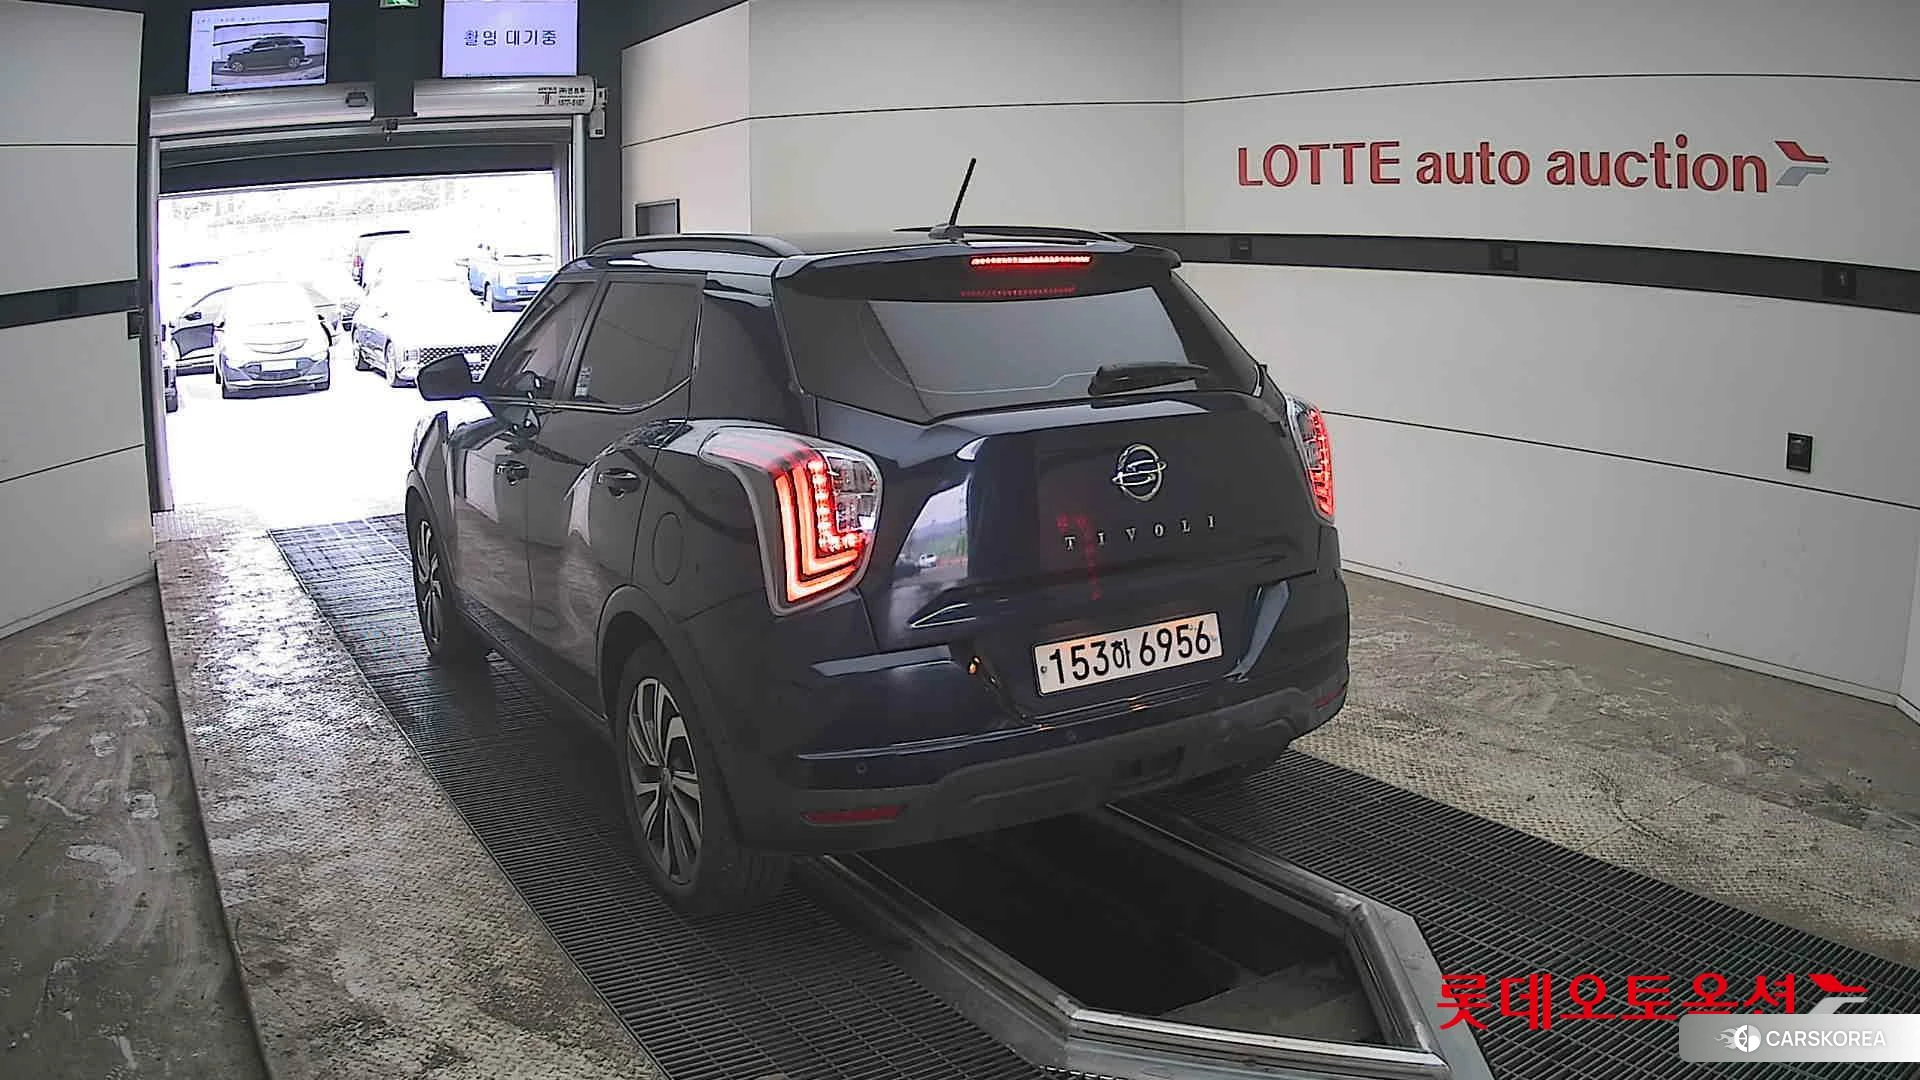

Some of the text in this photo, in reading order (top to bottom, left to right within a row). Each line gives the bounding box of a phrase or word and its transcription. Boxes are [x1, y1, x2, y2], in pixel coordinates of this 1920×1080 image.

[505, 29, 557, 46] 대기중
[1238, 134, 1768, 193] LOTTE auto auction
[1064, 514, 1216, 551] TIVOLI
